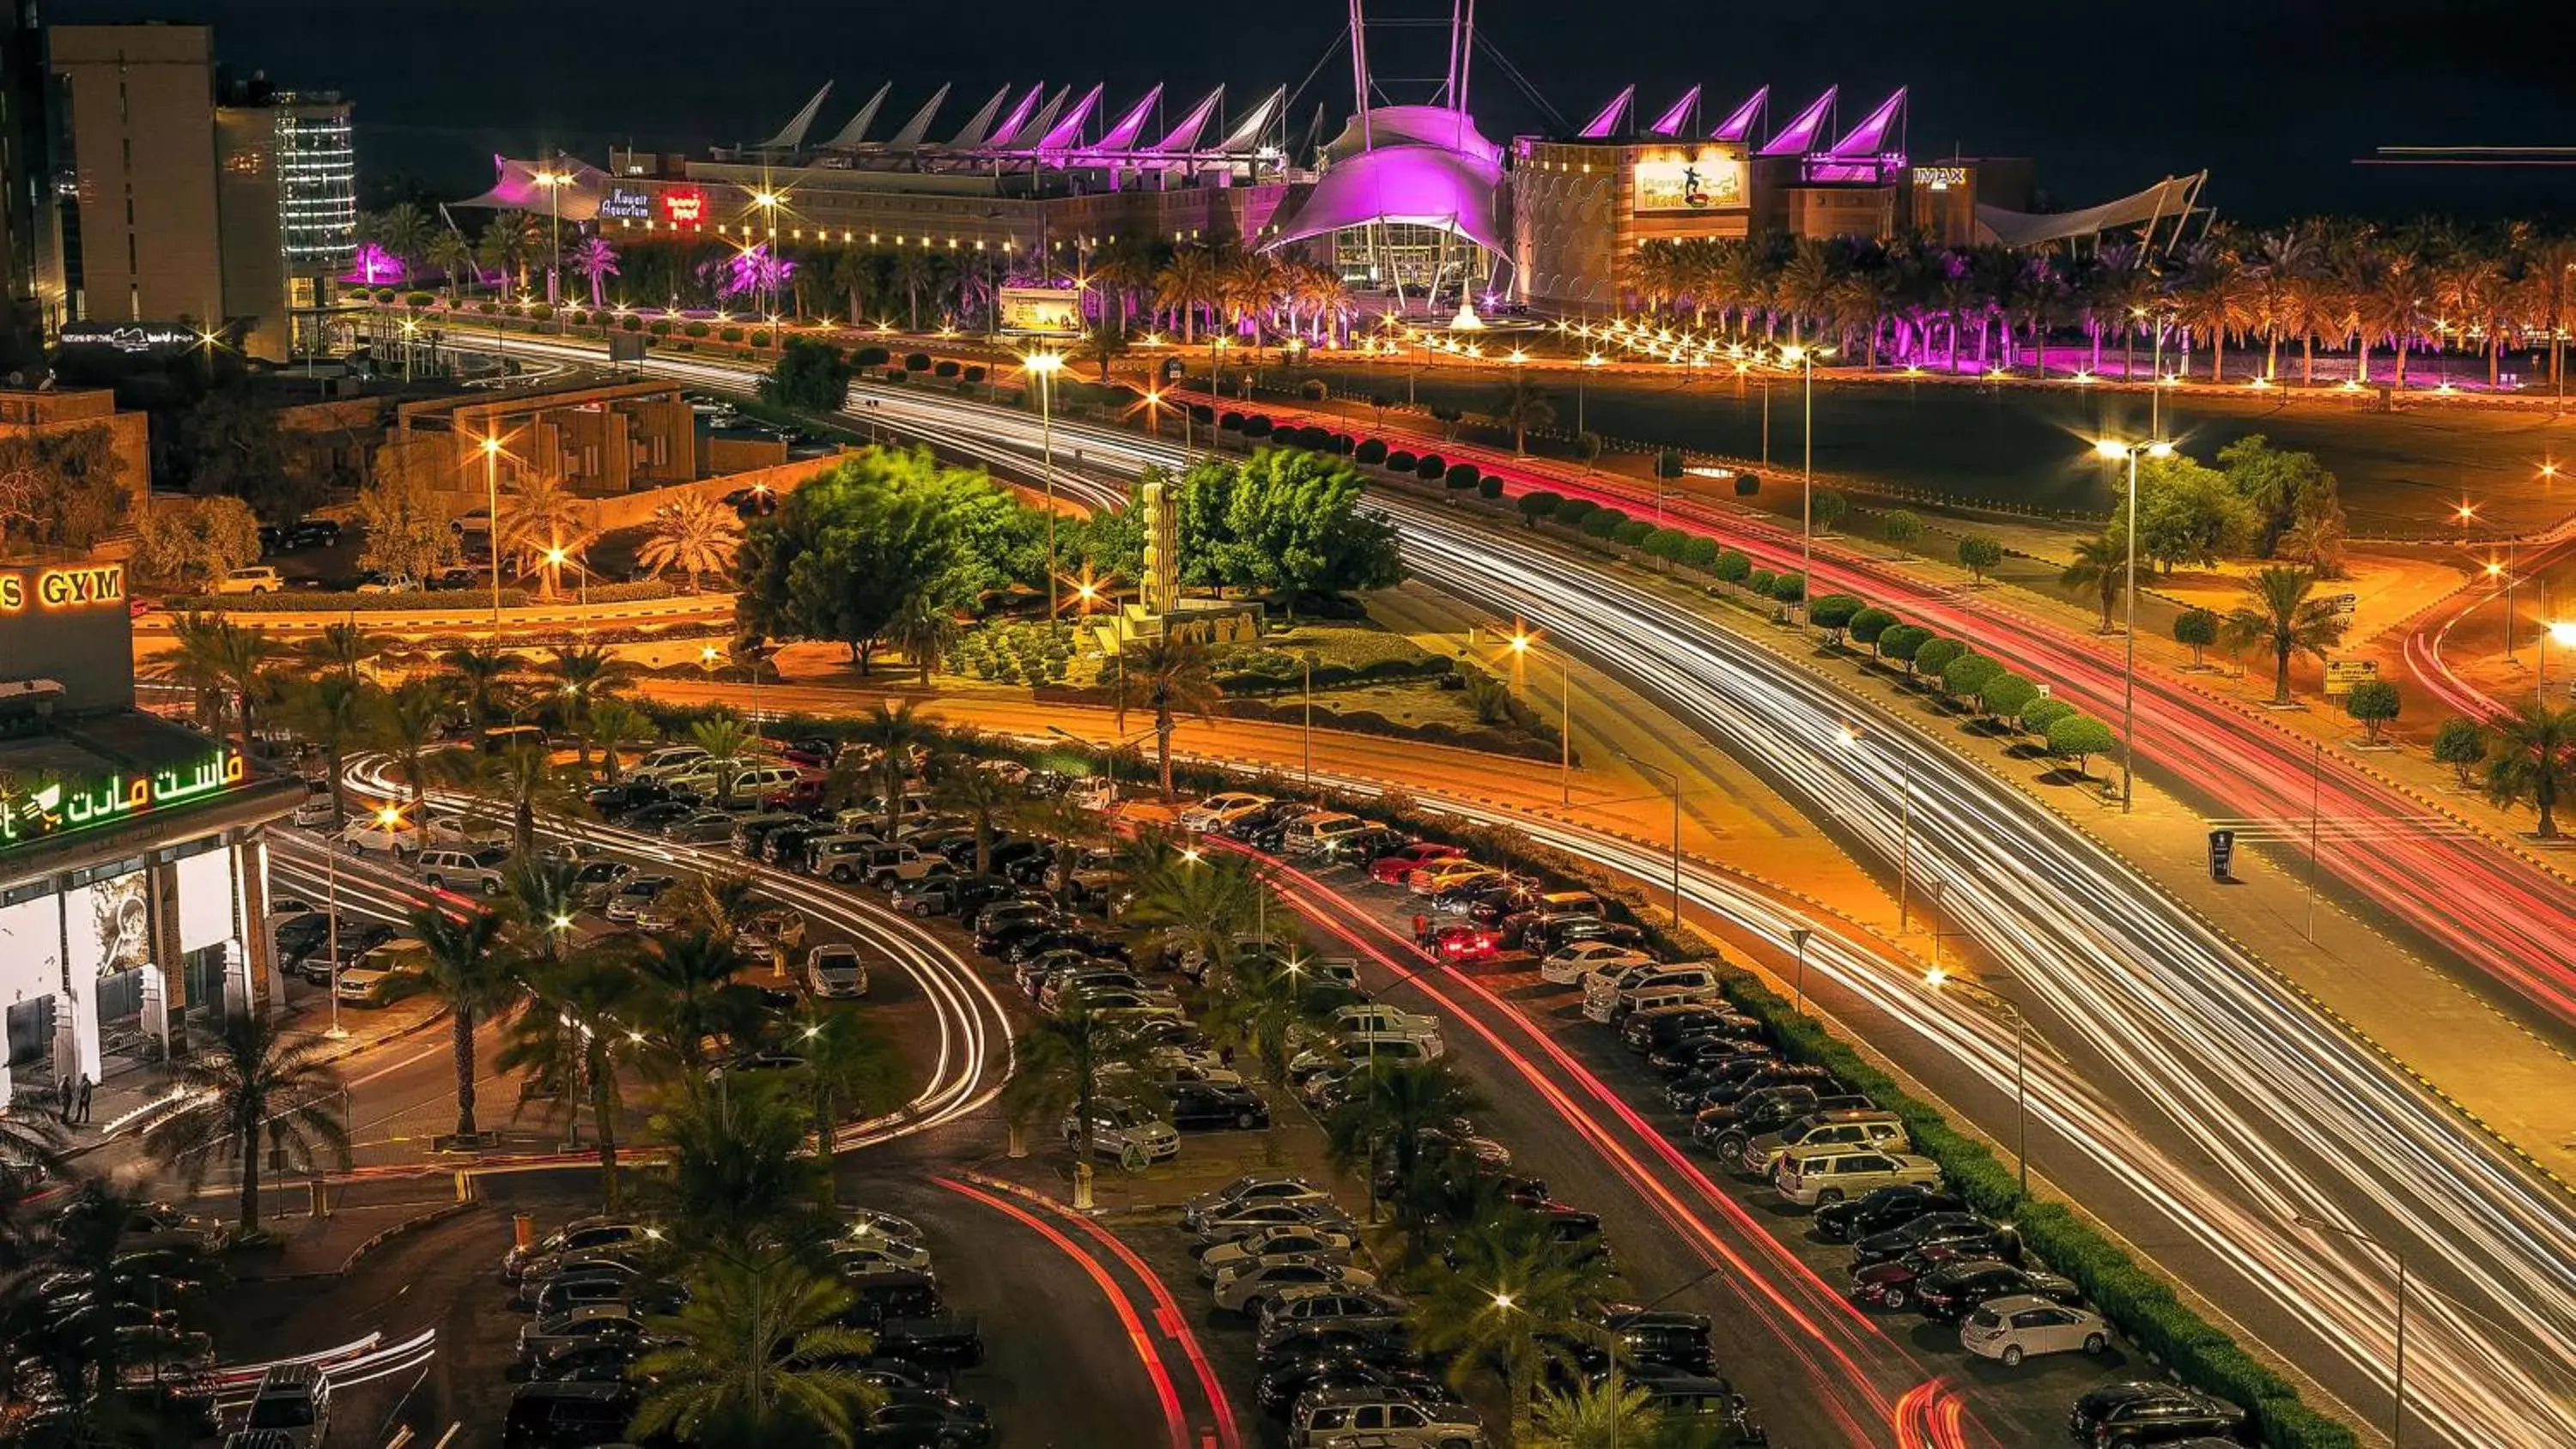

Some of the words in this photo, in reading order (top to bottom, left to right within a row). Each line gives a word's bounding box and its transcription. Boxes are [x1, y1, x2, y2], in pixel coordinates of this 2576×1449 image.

[1912, 167, 1965, 184] IMAX
[602, 199, 648, 217] Aquarium
[615, 188, 647, 205] Kuwait
[43, 569, 120, 603] GYM
[154, 748, 243, 801] فاست
[69, 774, 148, 822] مارت
